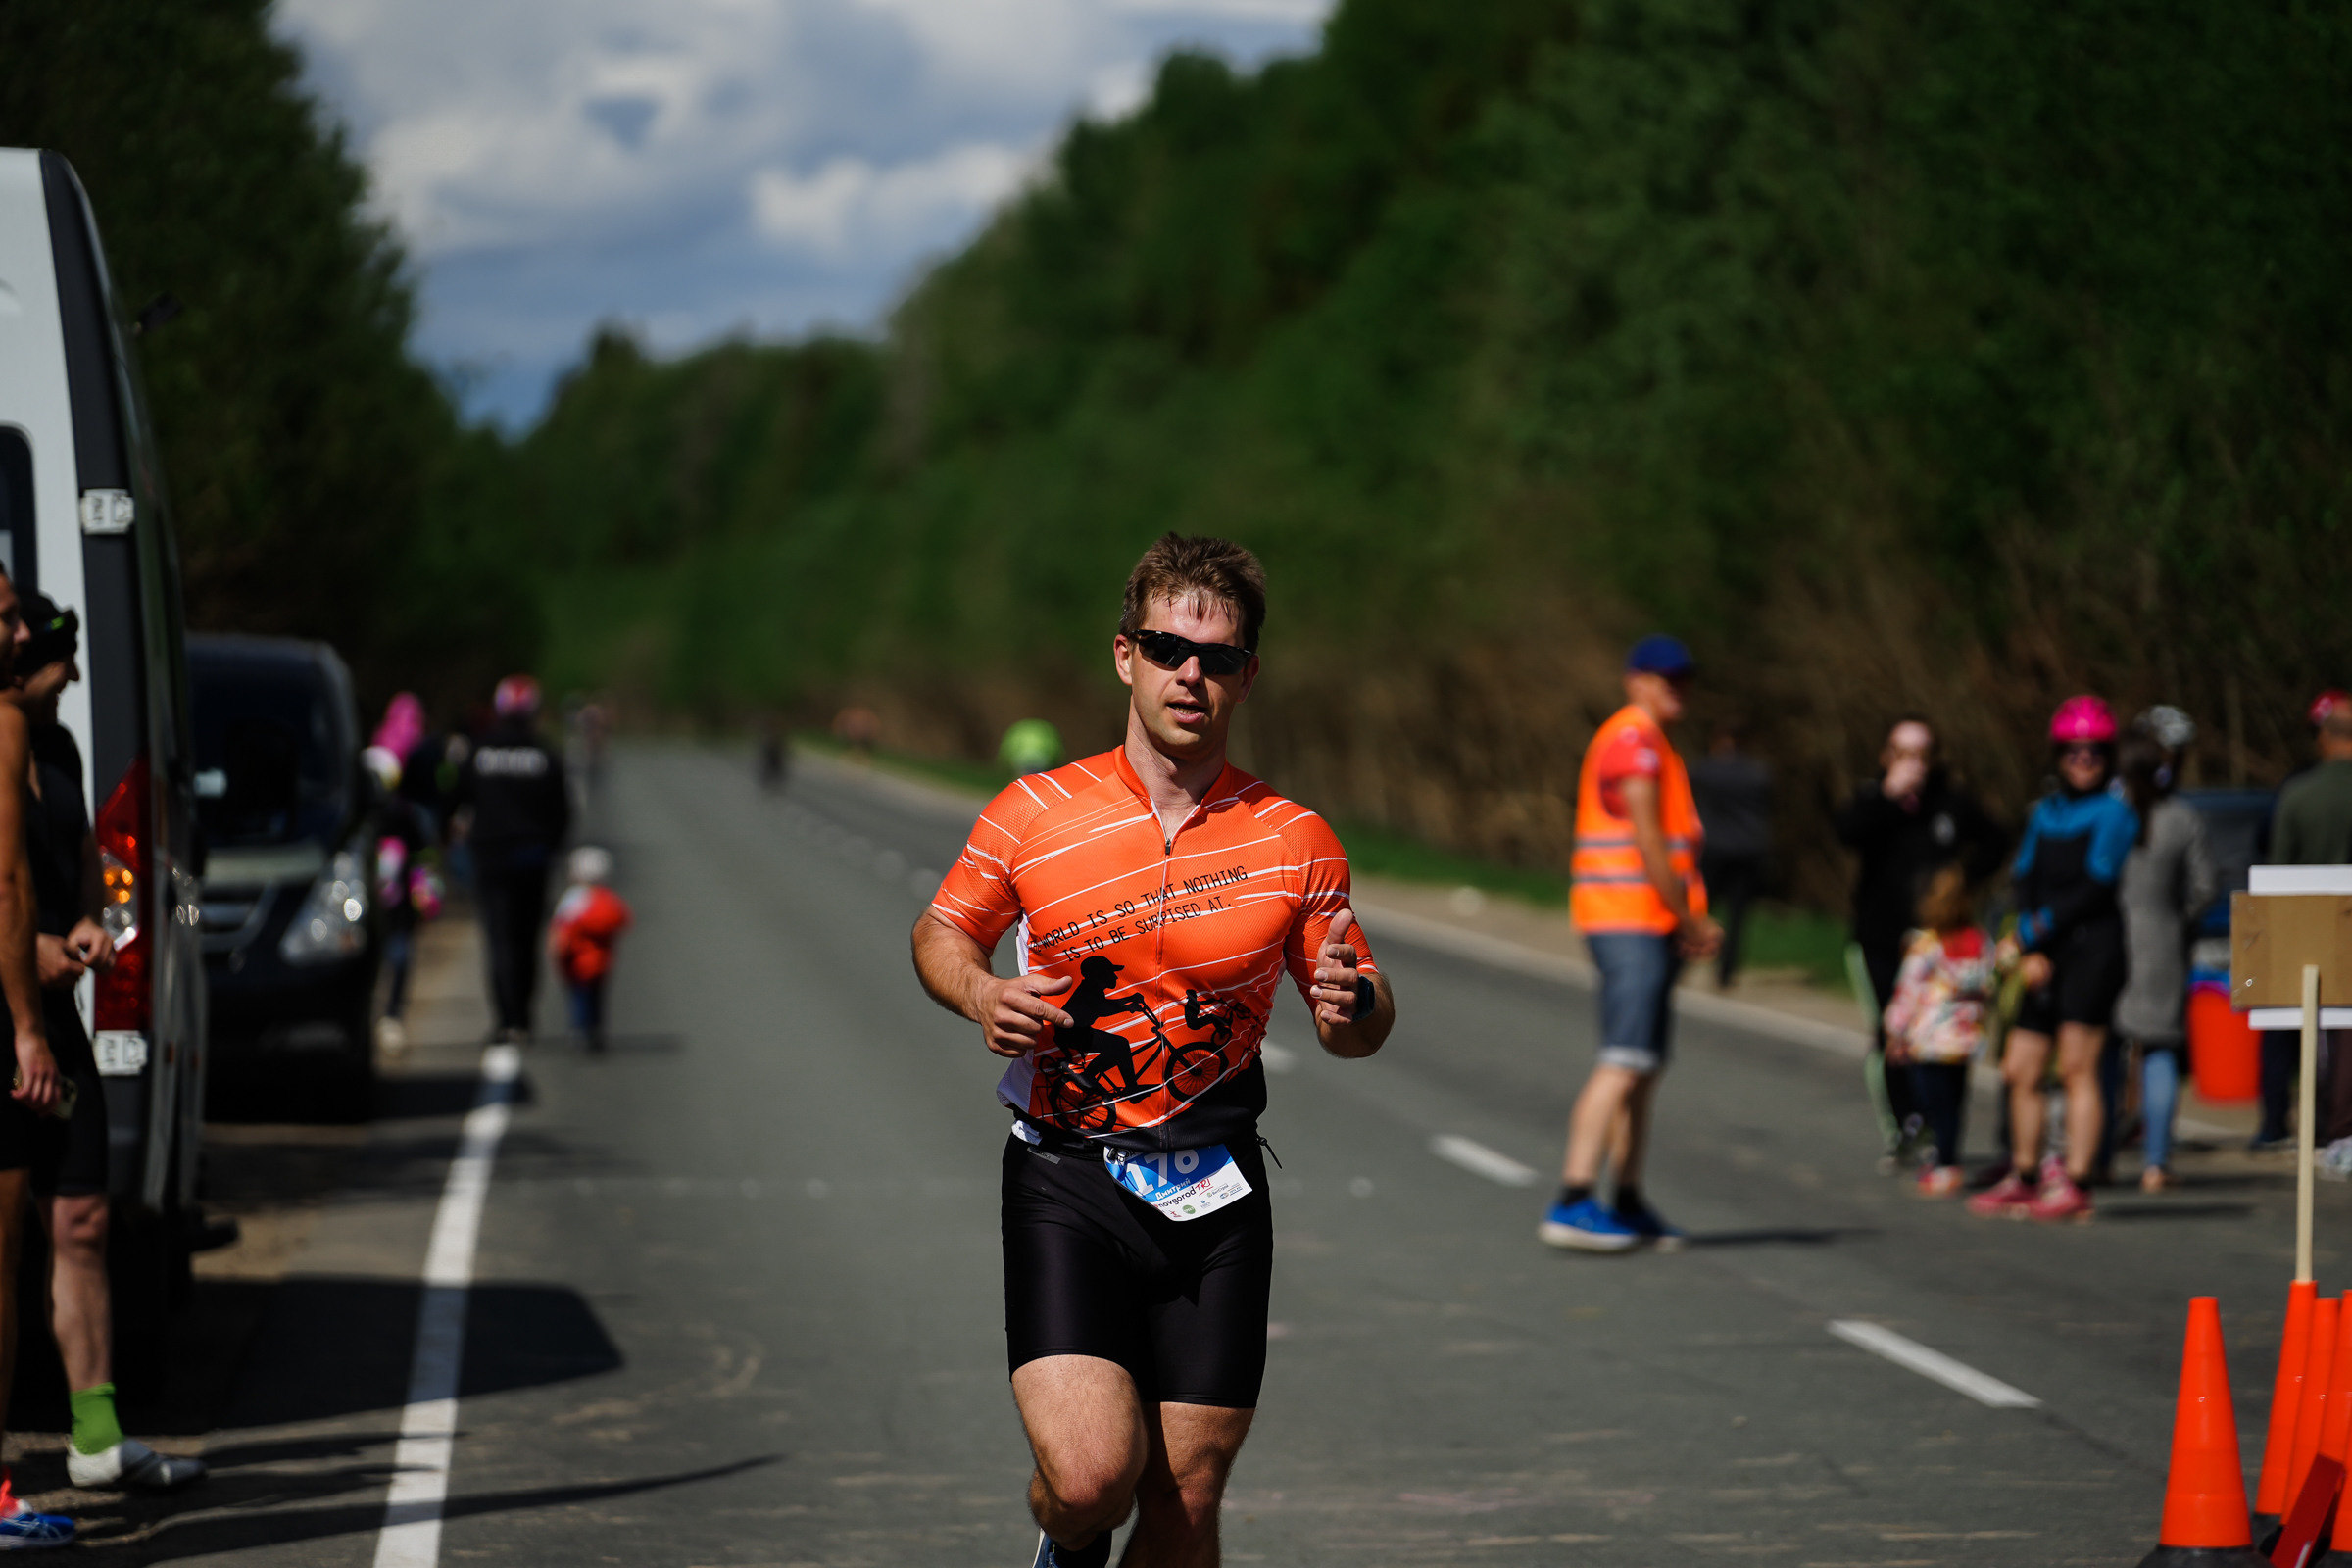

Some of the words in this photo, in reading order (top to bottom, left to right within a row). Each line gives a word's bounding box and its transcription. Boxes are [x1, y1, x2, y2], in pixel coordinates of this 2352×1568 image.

[1042, 921, 1080, 949] WORLD
[1087, 909, 1108, 929] IS
[1114, 900, 1136, 918] SO
[1140, 883, 1177, 909] THAT
[1183, 865, 1249, 895] NOTHING
[1062, 946, 1081, 962] IS
[1084, 935, 1104, 954] TO
[1109, 925, 1130, 944] BE
[1207, 896, 1232, 913] AT.
[1154, 1177, 1192, 1200] Дмитрий
